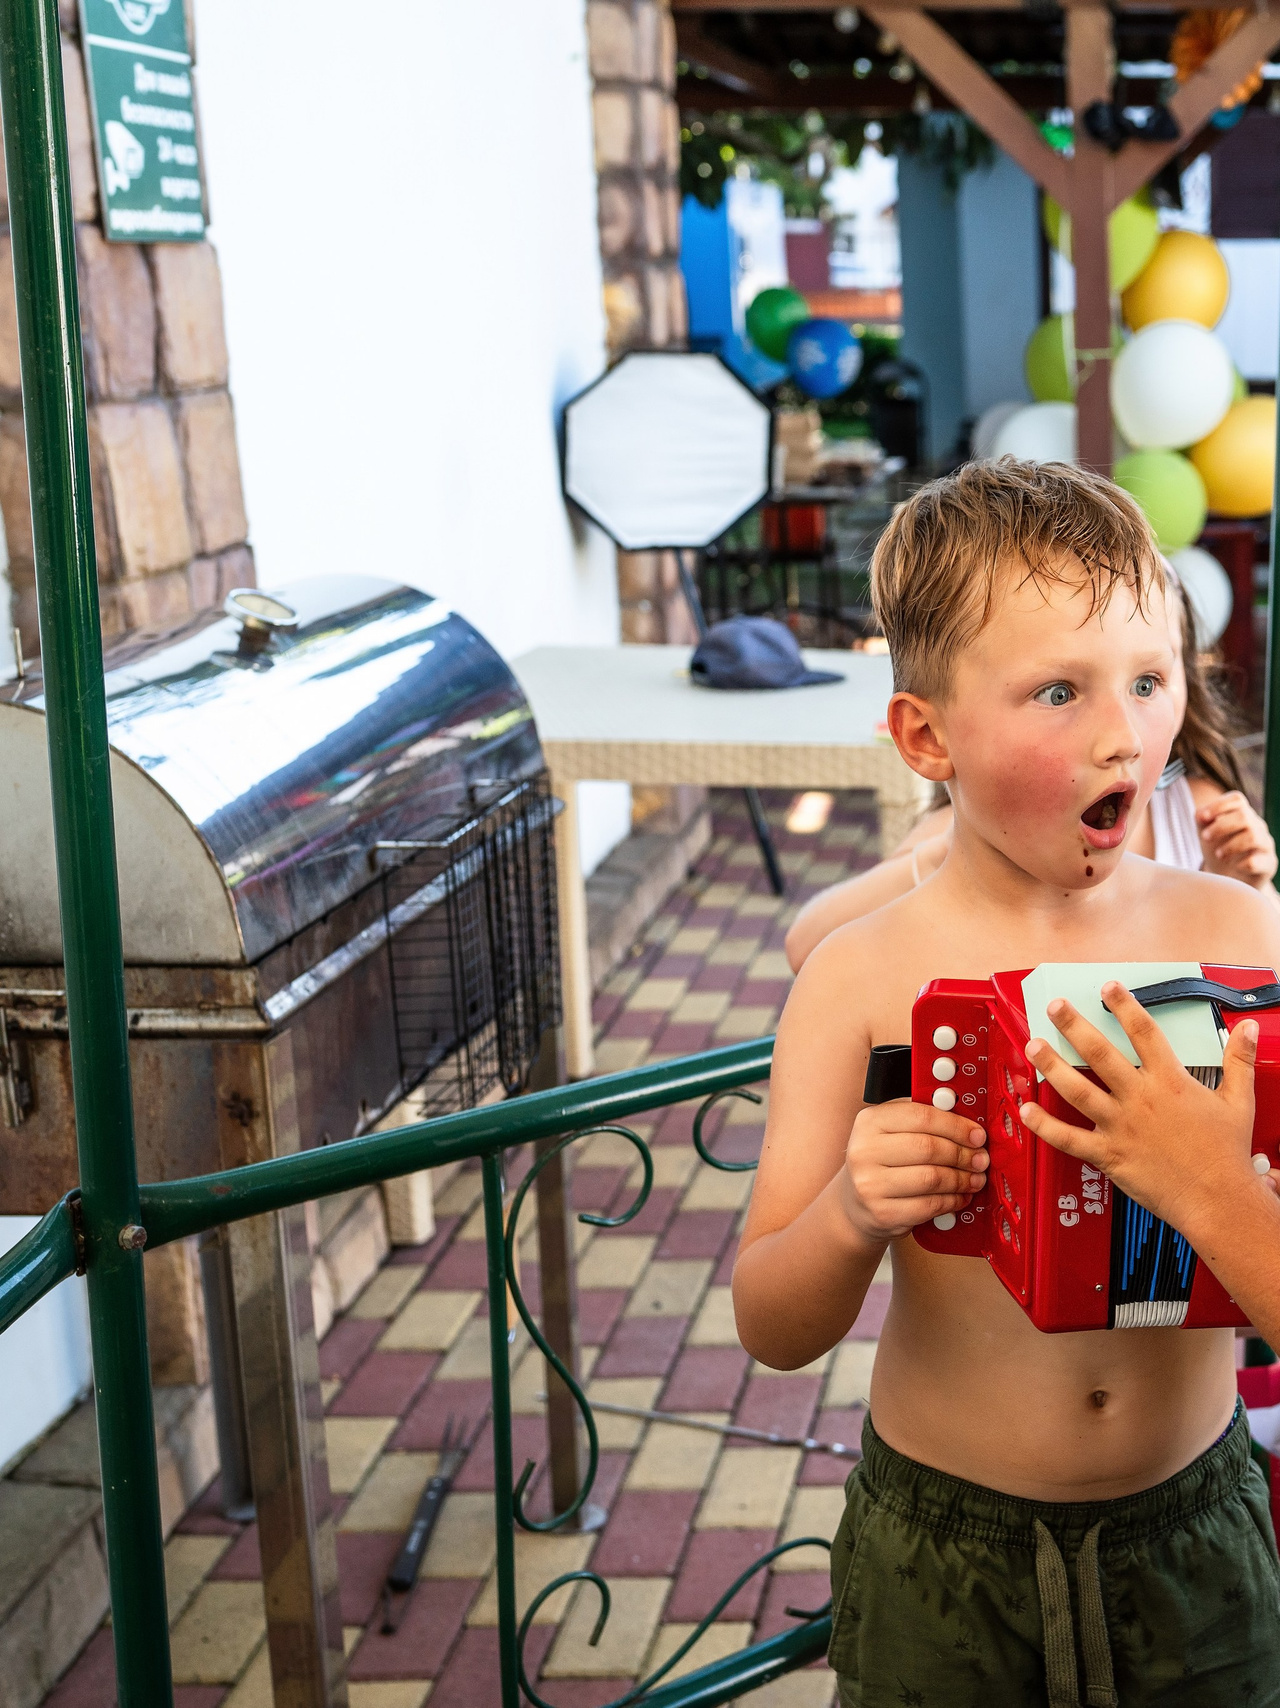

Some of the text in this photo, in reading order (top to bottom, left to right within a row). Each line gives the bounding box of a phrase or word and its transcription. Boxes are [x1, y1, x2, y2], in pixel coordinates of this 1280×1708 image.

[964, 1035, 975, 1044] D
[964, 1094, 975, 1104] A
[1081, 1163, 1104, 1215] SKY
[1058, 1194, 1080, 1227] CB
